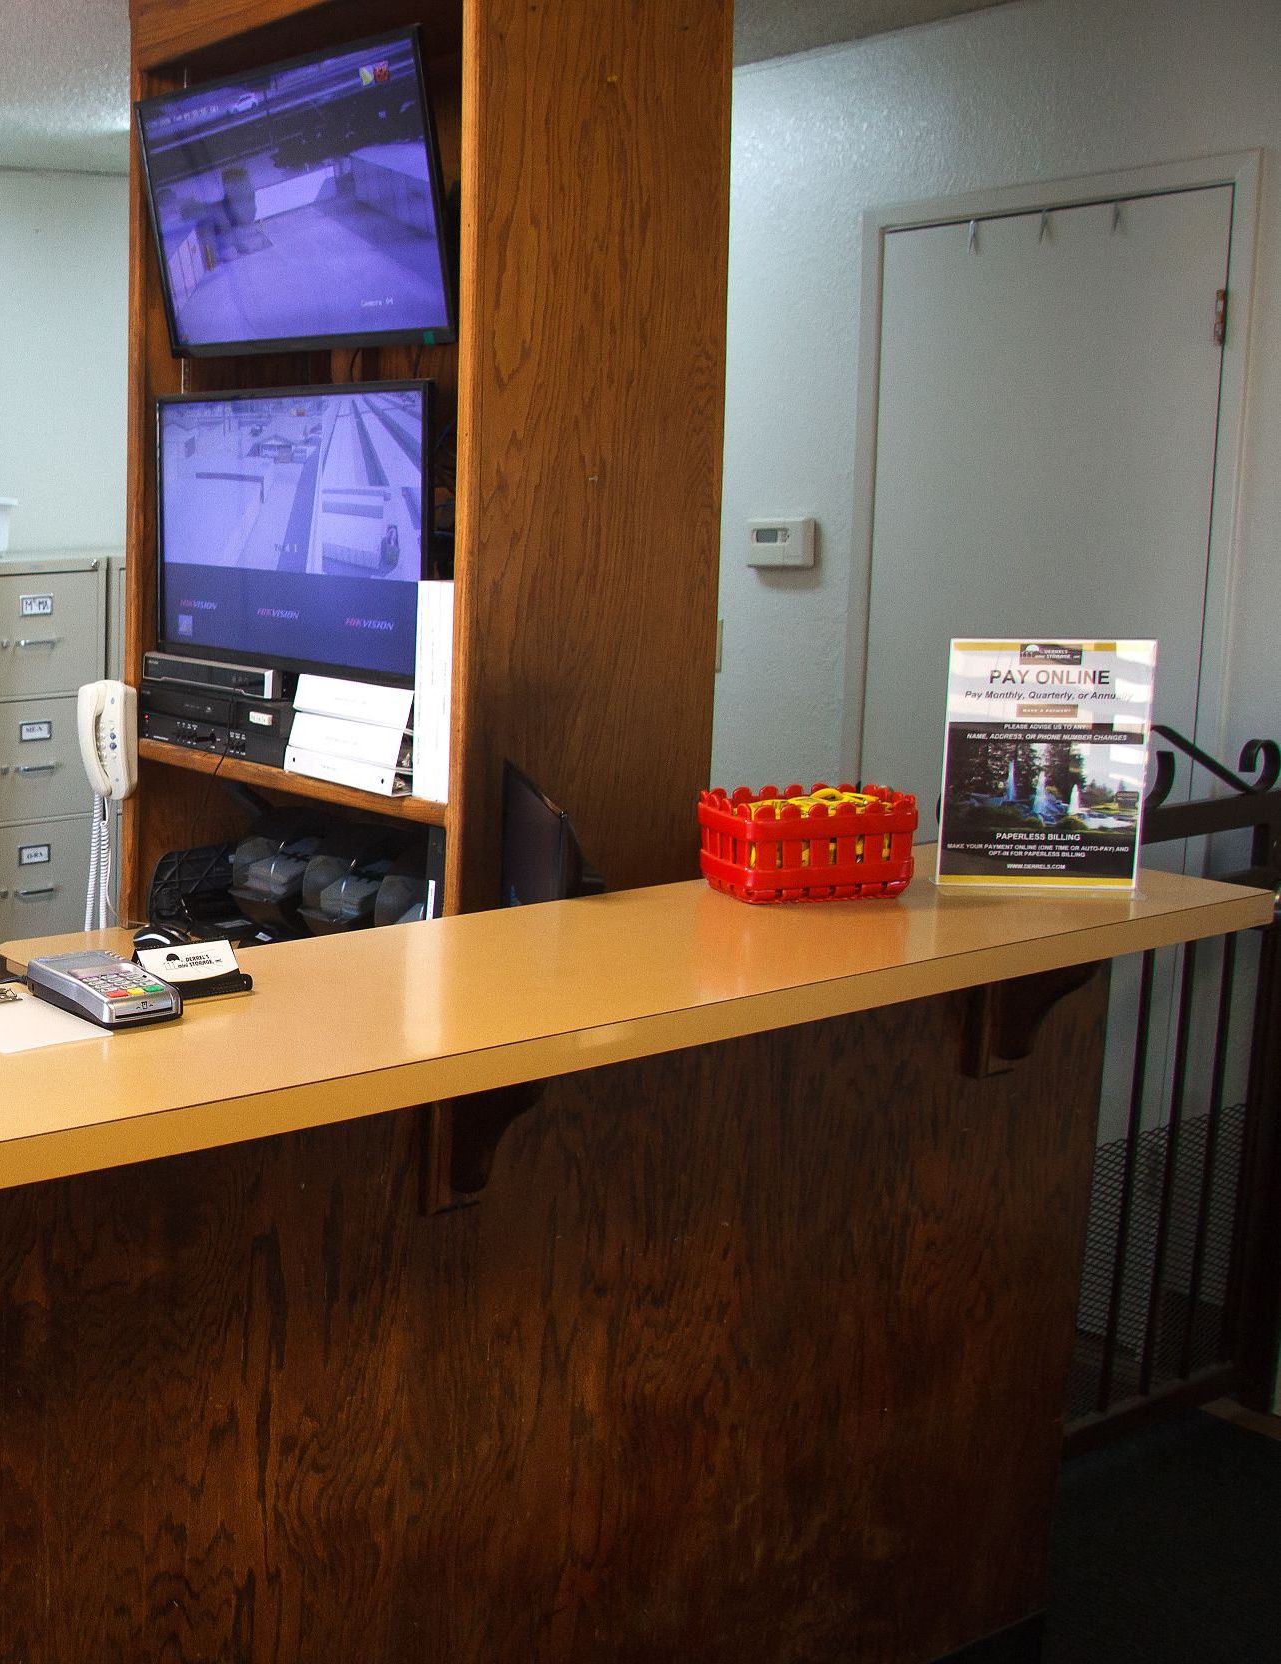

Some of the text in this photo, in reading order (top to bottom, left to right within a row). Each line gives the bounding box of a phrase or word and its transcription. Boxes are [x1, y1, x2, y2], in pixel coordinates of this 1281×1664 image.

[988, 669, 1110, 685] PAY ONLINE
[964, 690, 983, 700] Pay
[985, 690, 1025, 701] Monthly,
[1028, 690, 1075, 702] Quarterly,
[1077, 692, 1089, 700] or
[966, 732, 988, 740] NAME,
[1036, 733, 1061, 741] PHONE
[1062, 733, 1092, 741] NUMBER
[1093, 734, 1127, 742] CHANGES
[995, 832, 1081, 842] PAPERLESS BILLING
